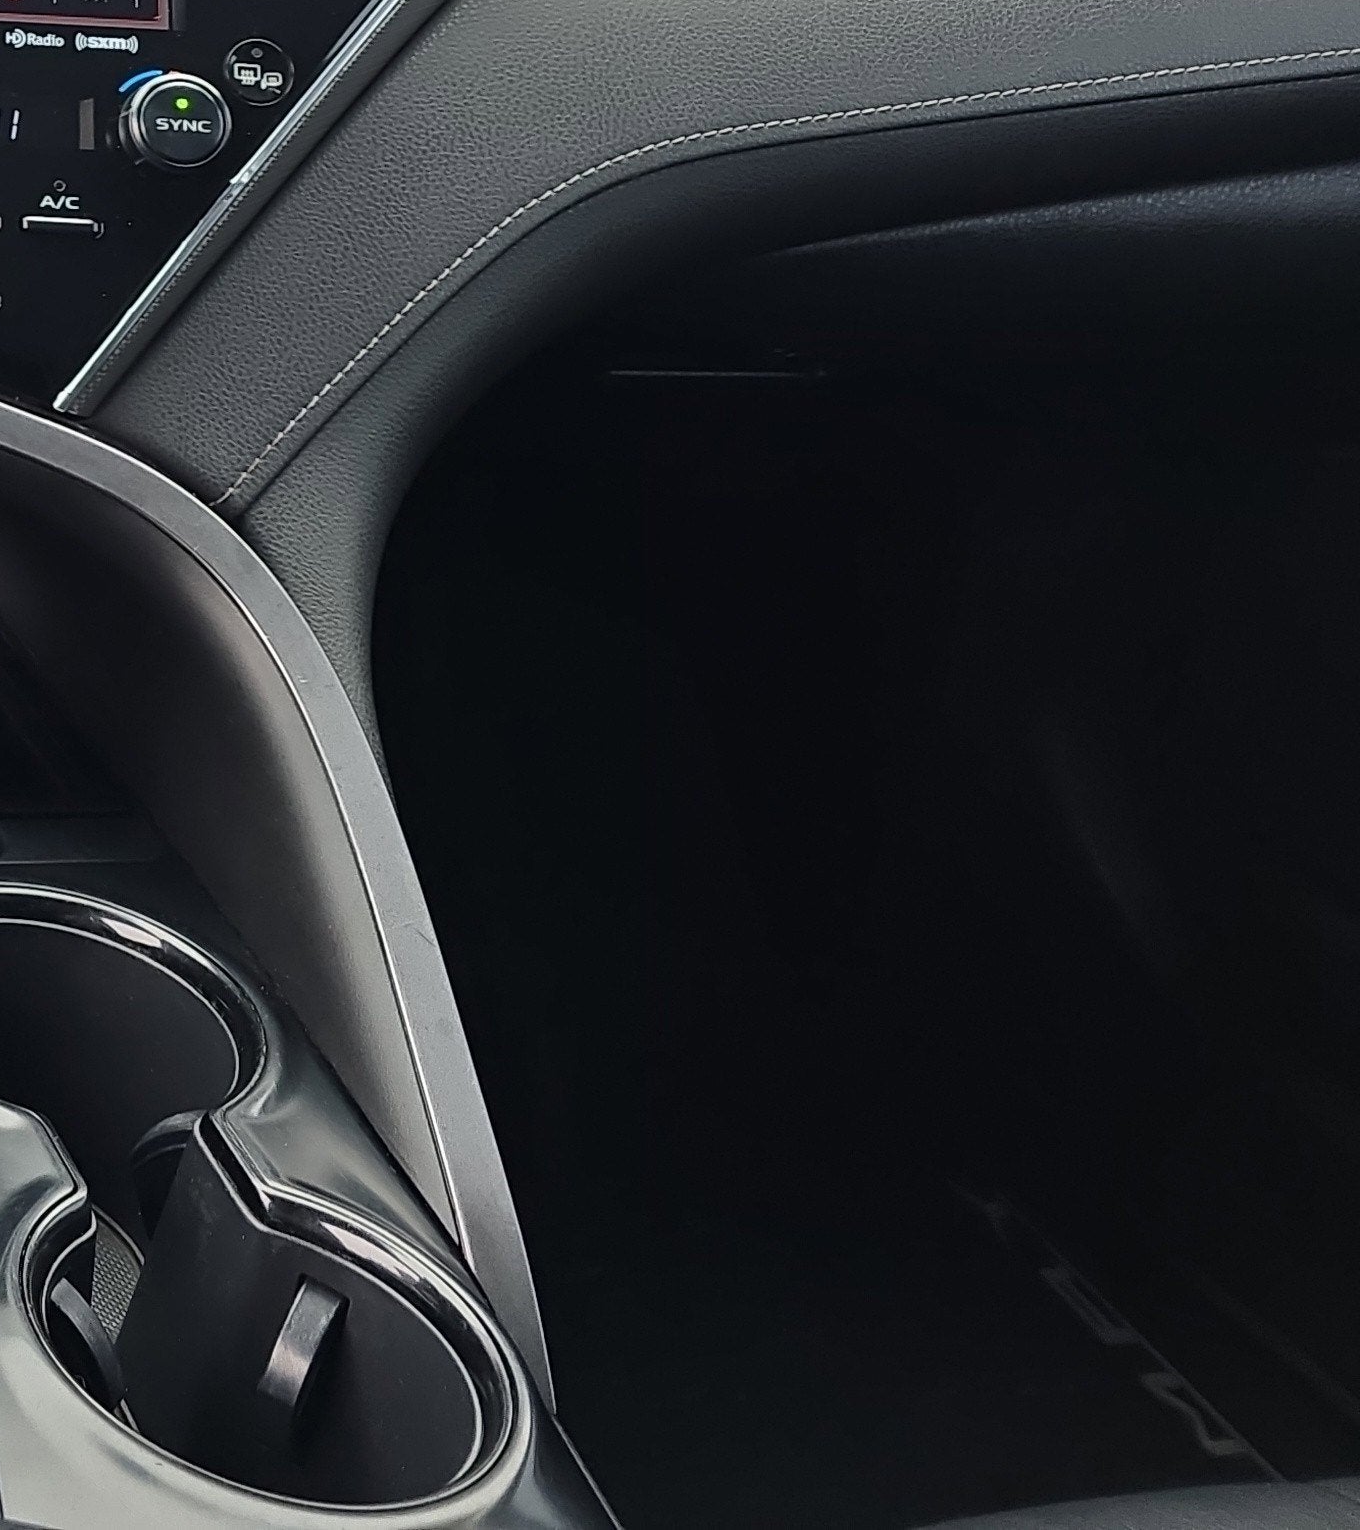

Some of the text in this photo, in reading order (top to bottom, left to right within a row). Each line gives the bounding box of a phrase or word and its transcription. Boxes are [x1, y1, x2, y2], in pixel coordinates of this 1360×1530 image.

[27, 32, 66, 49] Radio
[154, 116, 213, 135] SYNC
[39, 194, 81, 211] A/C
